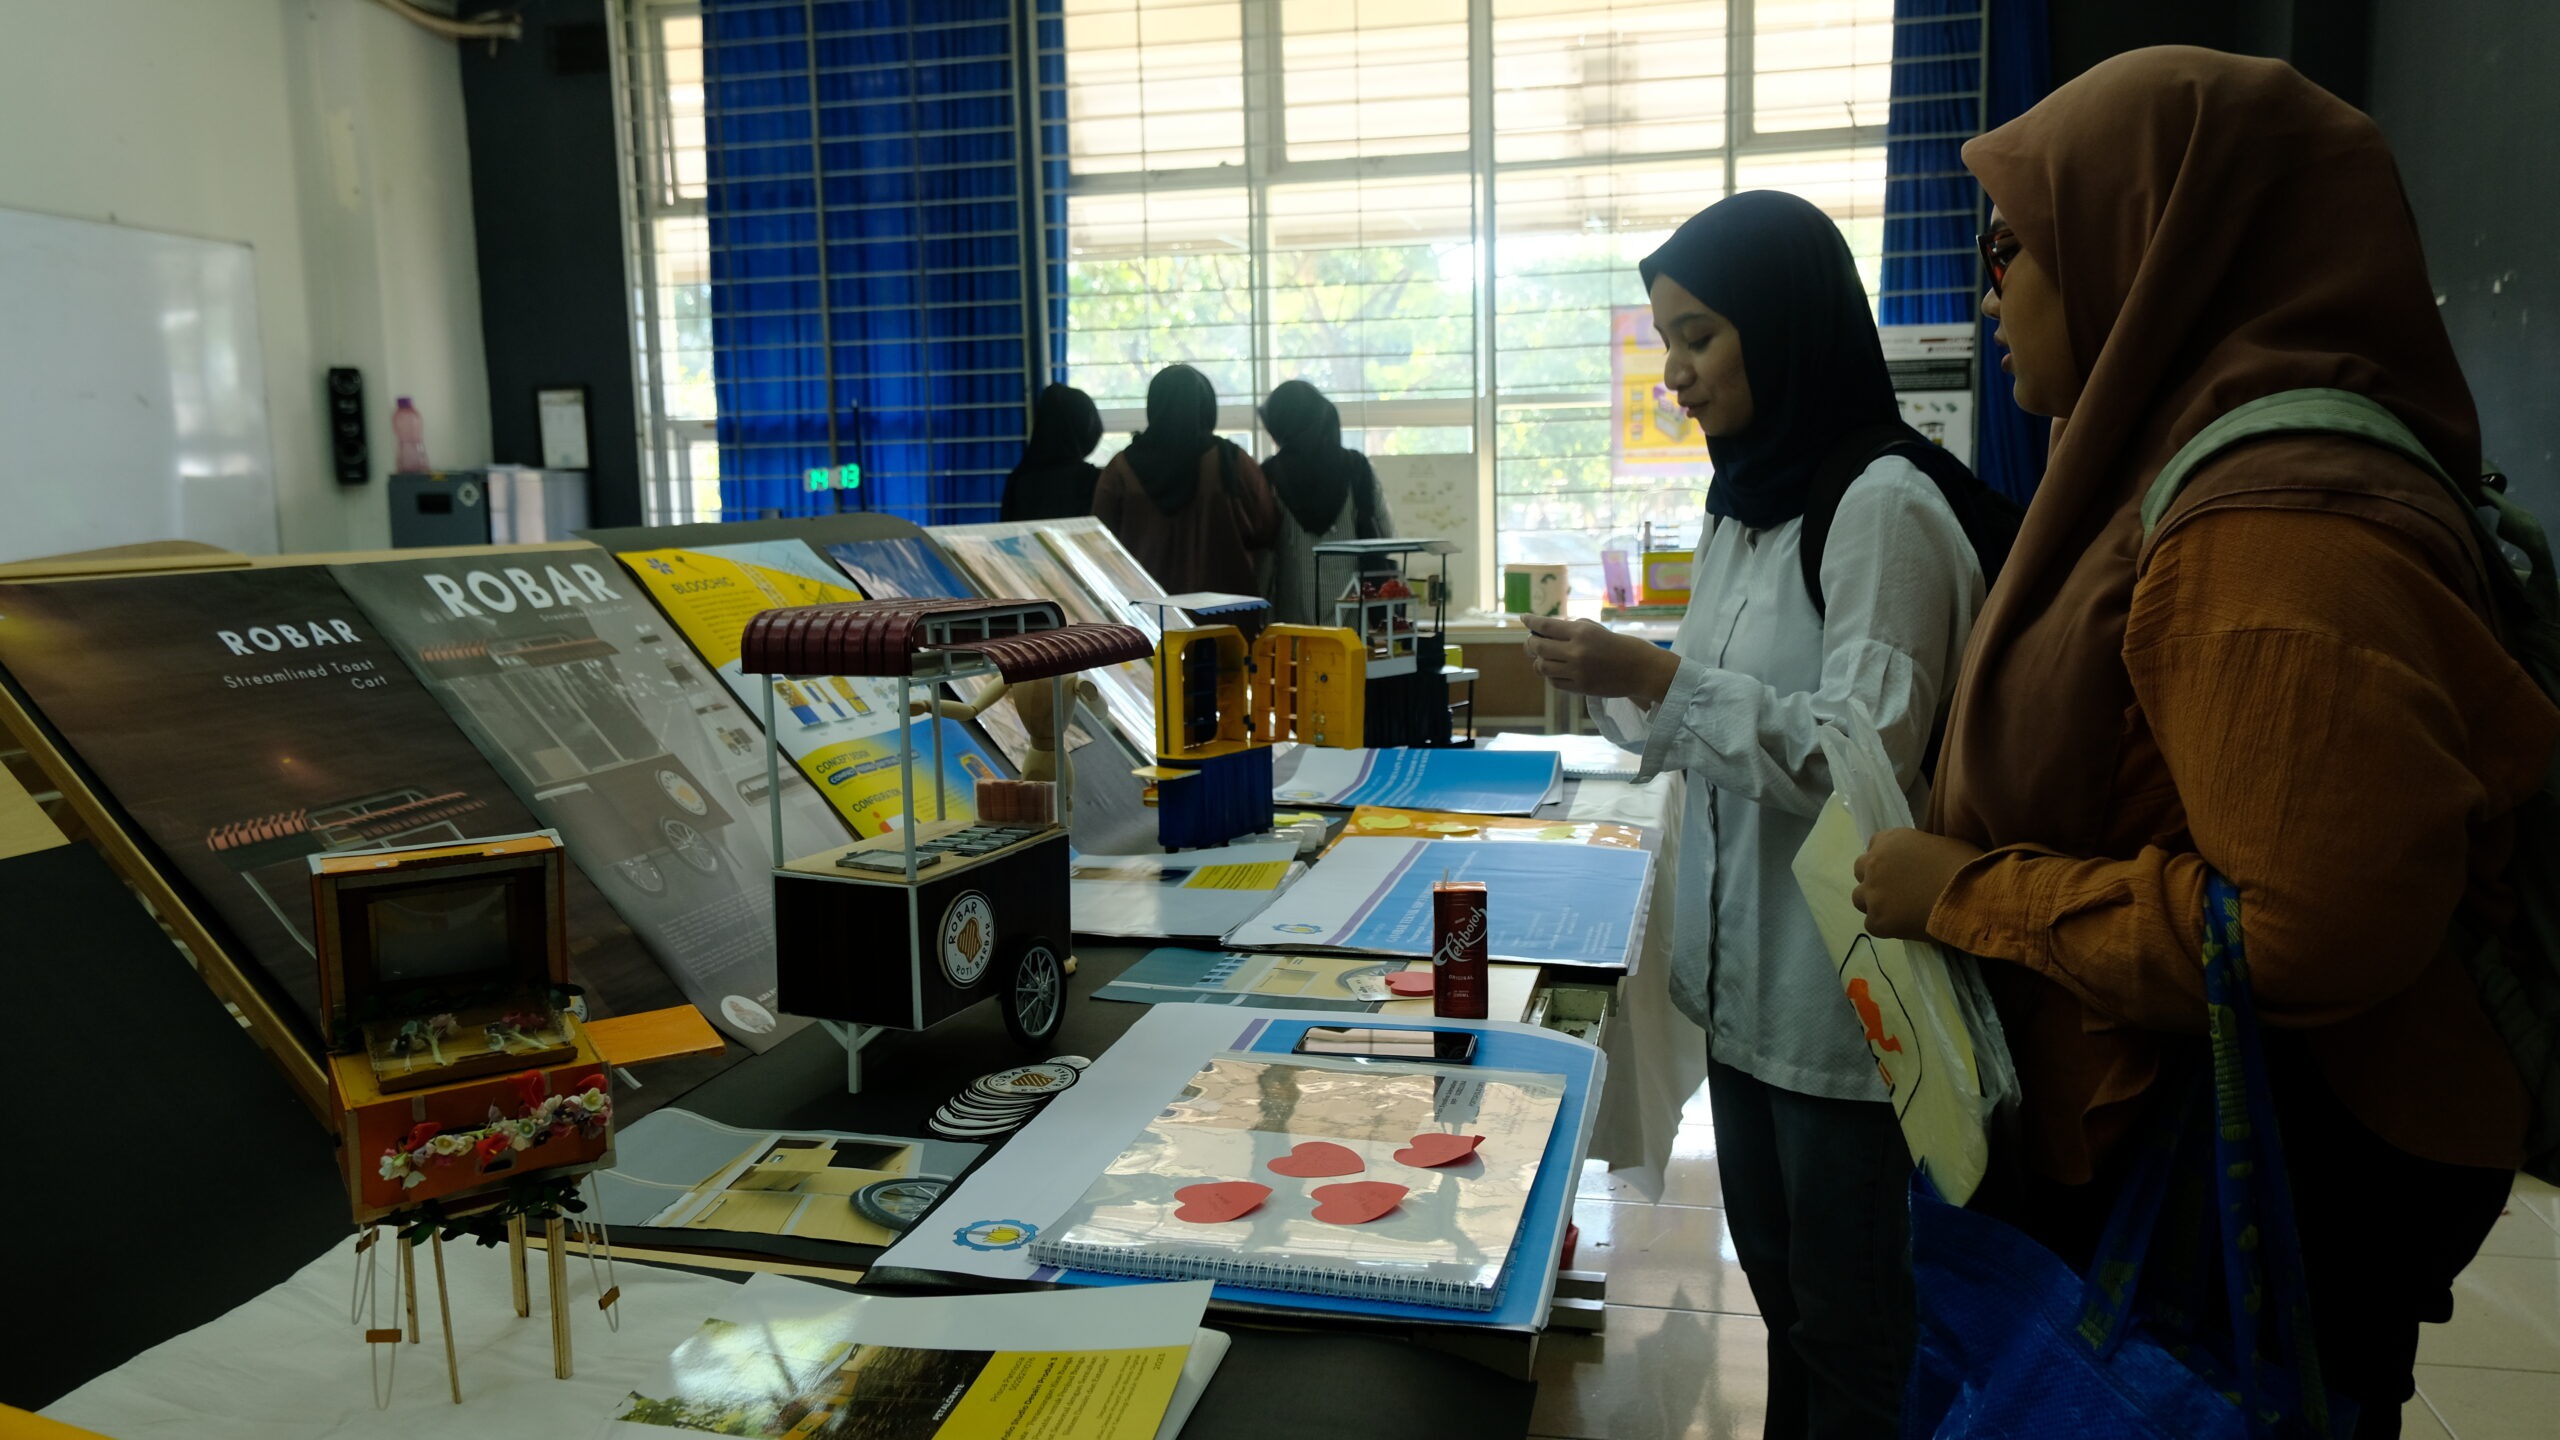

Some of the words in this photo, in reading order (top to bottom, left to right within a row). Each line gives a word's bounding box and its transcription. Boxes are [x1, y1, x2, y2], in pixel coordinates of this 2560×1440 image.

[423, 563, 622, 618] ROBAR
[216, 618, 362, 657] ROBAR
[223, 663, 328, 690] Streamlined
[331, 659, 376, 675] Toast
[351, 675, 389, 690] Cart
[949, 901, 978, 945] ROBAR
[957, 964, 973, 976] ROTI
[994, 1068, 1031, 1087] ROBAR
[1153, 1353, 1167, 1369] 2021
[932, 1383, 965, 1421] PETALCRATE
[1011, 1406, 1029, 1425] Studio
[1025, 1384, 1043, 1404] Desain
[1038, 1362, 1055, 1383] Produk
